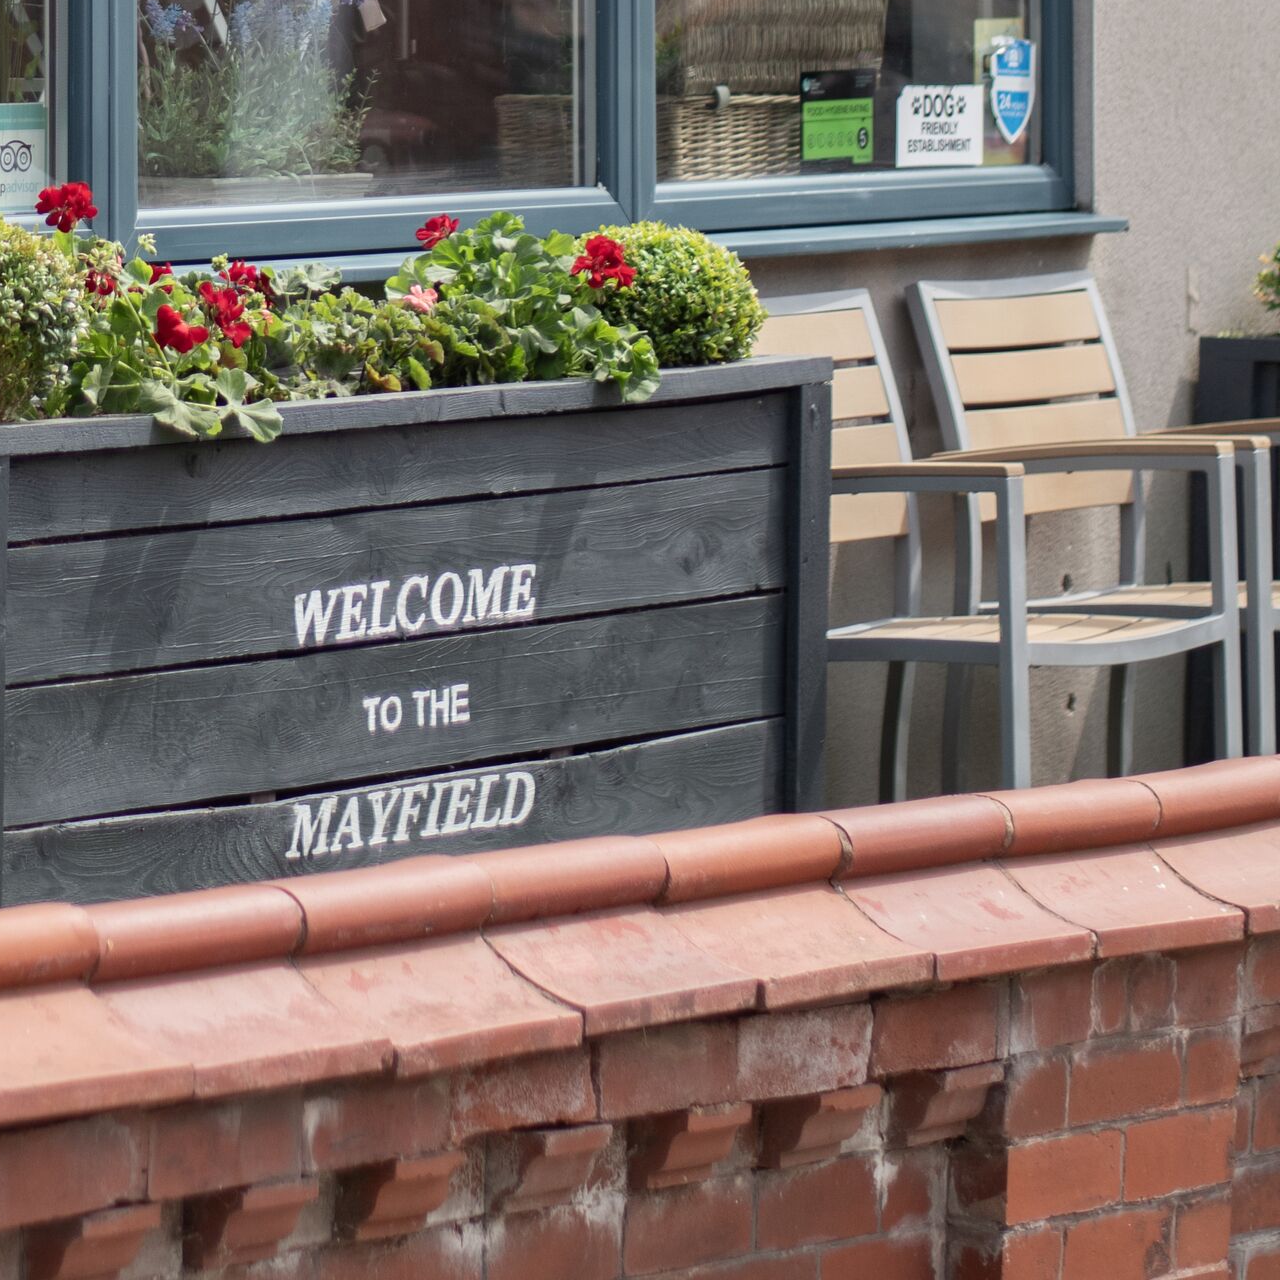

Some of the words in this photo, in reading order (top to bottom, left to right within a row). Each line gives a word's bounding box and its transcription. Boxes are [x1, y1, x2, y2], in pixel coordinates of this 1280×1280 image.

[923, 94, 954, 117] DOG
[999, 93, 1011, 110] 24
[921, 121, 959, 135] FRIENDLY
[907, 138, 972, 153] ESTABLISHMENT
[294, 564, 536, 646] WELCOME
[363, 696, 402, 731] TO
[412, 683, 470, 727] THE
[285, 771, 536, 858] MAYFIELD
